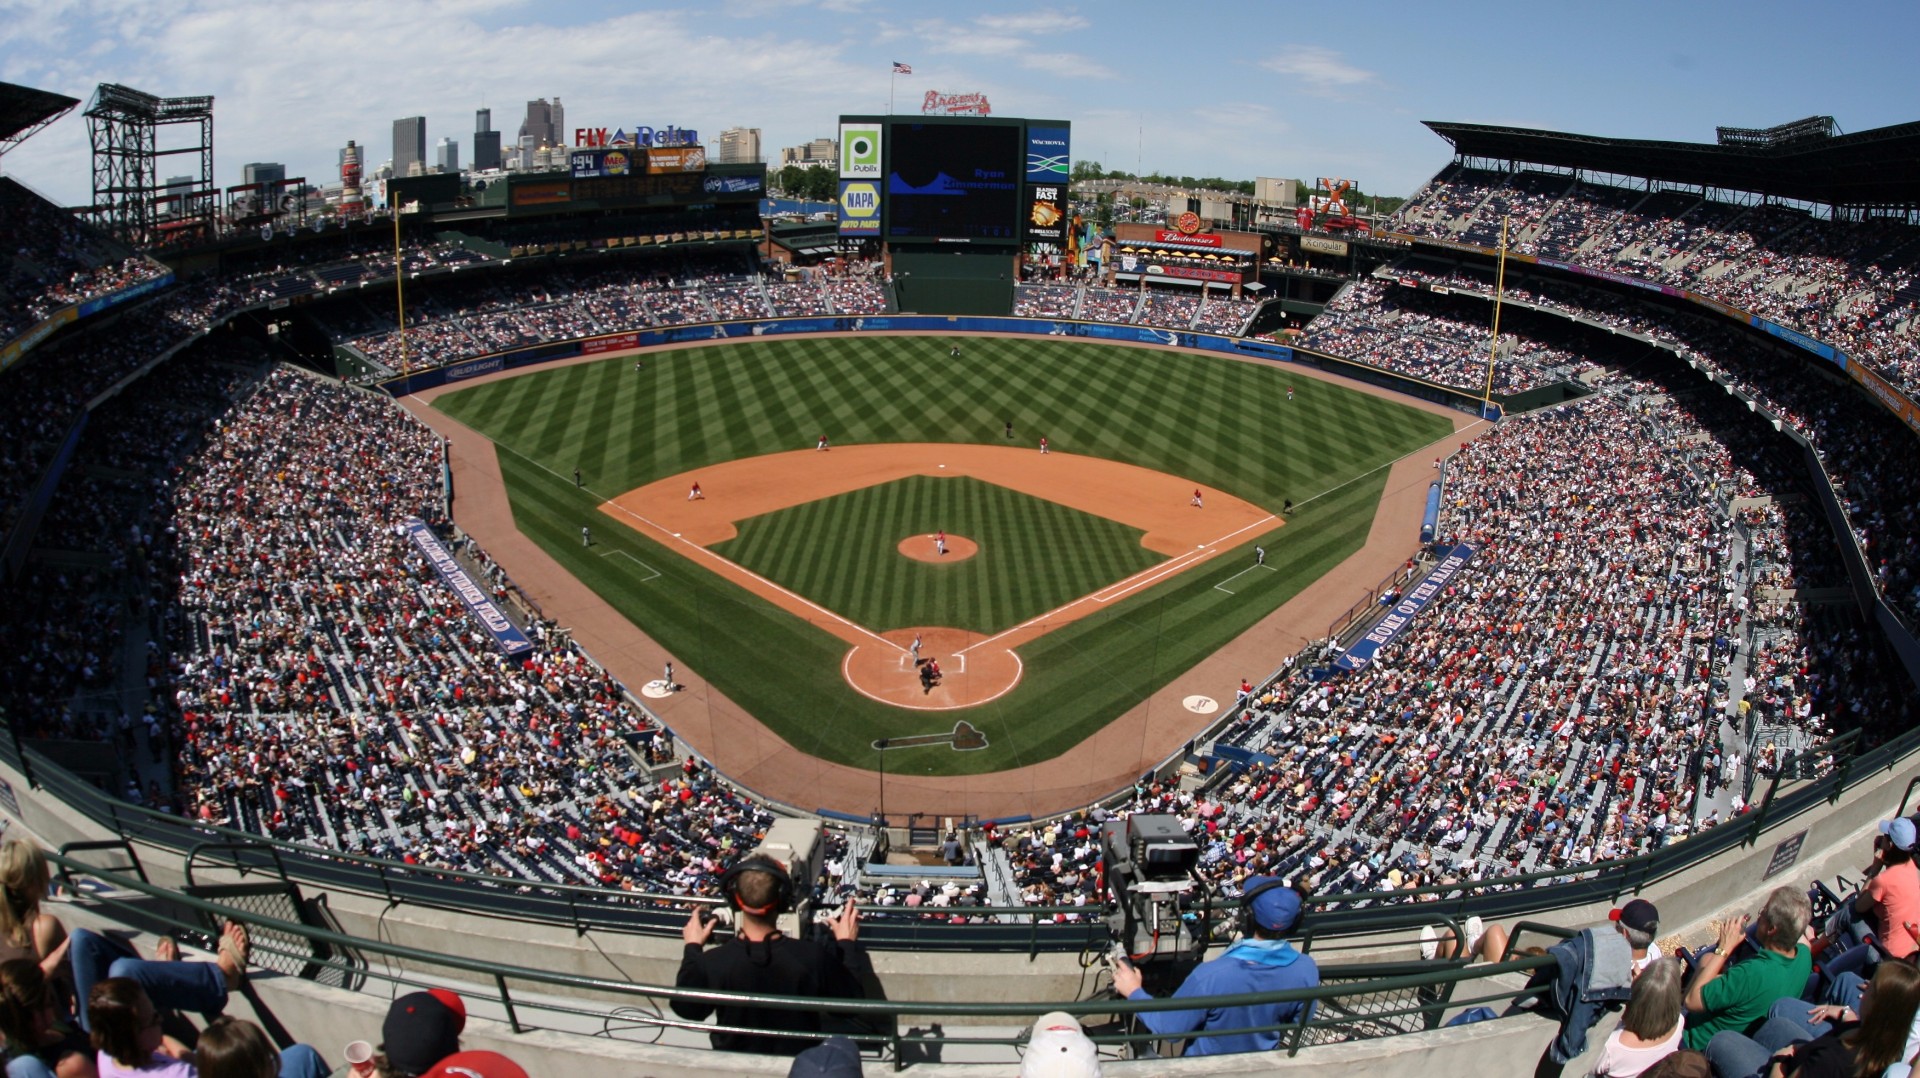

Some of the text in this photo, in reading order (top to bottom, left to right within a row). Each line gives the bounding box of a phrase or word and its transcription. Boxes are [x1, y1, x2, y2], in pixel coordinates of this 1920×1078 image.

[923, 90, 980, 112] Braves
[576, 125, 698, 147] FLY Delta
[975, 168, 1005, 179] Ryan
[944, 180, 1016, 190] Zimmerman
[848, 193, 874, 208] NAPA
[1162, 232, 1215, 244] Budweiser
[1312, 241, 1342, 252] cingular
[454, 360, 500, 376] BUD LIGHT
[438, 560, 458, 573] TO
[447, 570, 486, 605] TURNER
[1366, 555, 1464, 644] HOME OF THE BRAVES
[474, 601, 510, 632] FIELD
